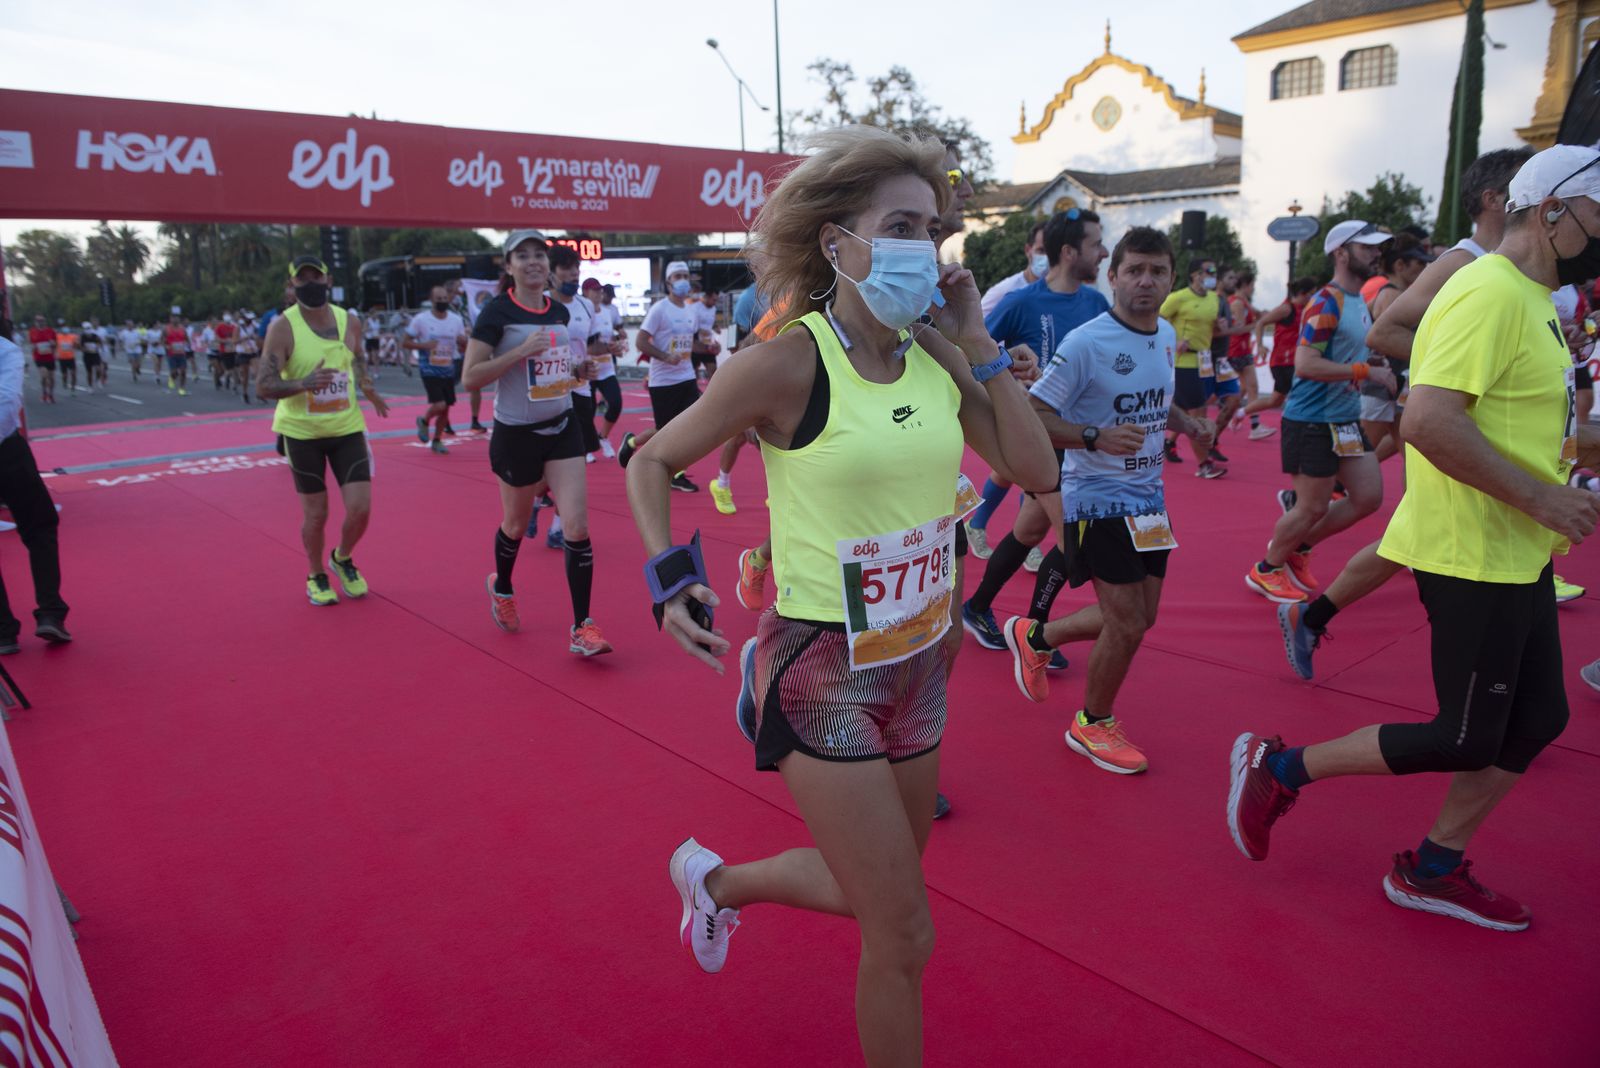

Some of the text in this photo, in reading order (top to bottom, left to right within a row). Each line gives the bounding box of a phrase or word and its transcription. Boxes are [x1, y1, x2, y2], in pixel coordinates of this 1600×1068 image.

[76, 129, 217, 176] HOKA
[288, 128, 394, 207] edp
[448, 151, 504, 197] edp
[551, 157, 641, 180] maratón
[700, 158, 766, 220] edp
[511, 196, 609, 211] 17 octubre 2021
[892, 404, 912, 417] NIKE
[1113, 386, 1165, 414] CXM
[1115, 415, 1137, 426] LOS
[853, 540, 880, 557] edp
[903, 529, 923, 547] edp
[862, 547, 942, 605] 5779
[1251, 741, 1269, 768] HOKA
